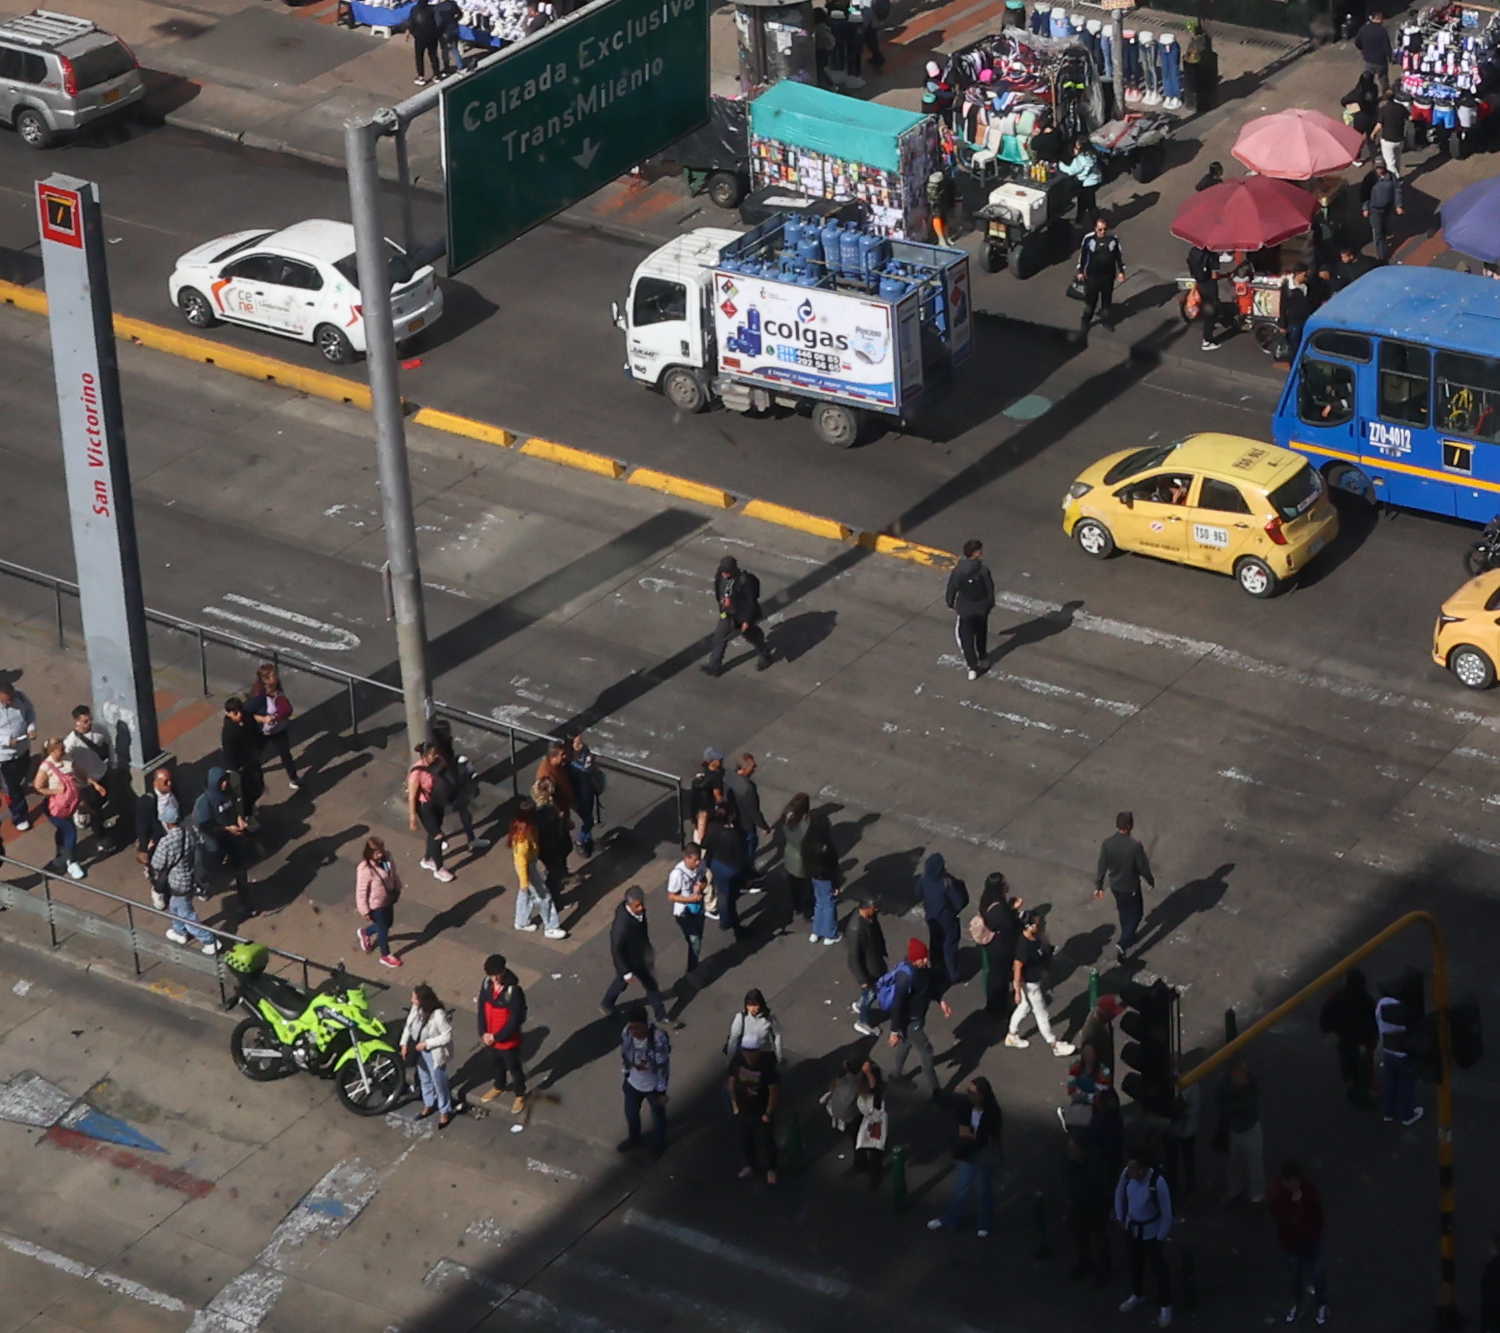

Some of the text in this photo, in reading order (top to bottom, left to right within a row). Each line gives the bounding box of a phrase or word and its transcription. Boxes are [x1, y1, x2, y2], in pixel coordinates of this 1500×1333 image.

[463, 62, 567, 132] Calzada
[502, 58, 664, 162] TransMilenio
[764, 319, 849, 351] colgas
[79, 371, 105, 470] Victorino
[1369, 422, 1412, 449] Z70-4012
[92, 478, 110, 518] San
